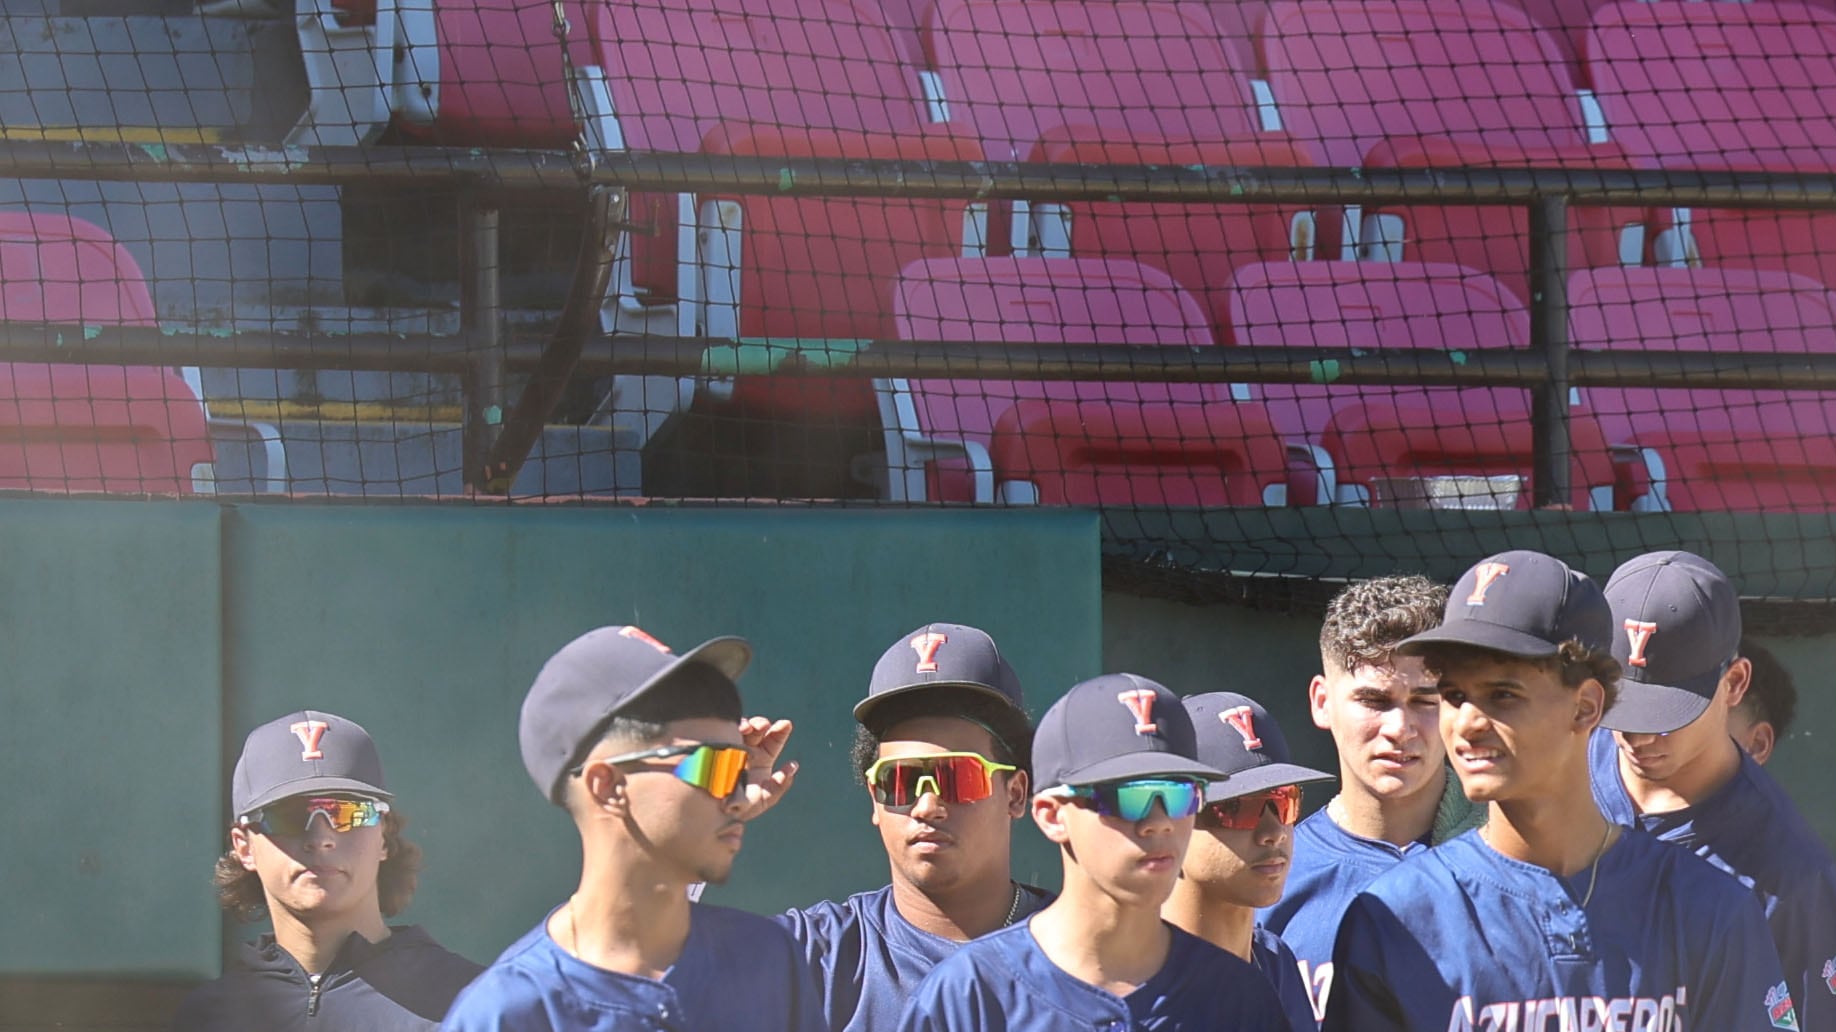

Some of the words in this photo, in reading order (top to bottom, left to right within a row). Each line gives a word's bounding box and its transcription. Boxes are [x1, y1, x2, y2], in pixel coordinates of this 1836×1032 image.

[1467, 562, 1510, 606] Y
[910, 633, 948, 674] Y
[1623, 619, 1657, 668] Y
[1118, 689, 1158, 735] Y
[1219, 705, 1263, 750] Y
[291, 720, 329, 761] Y
